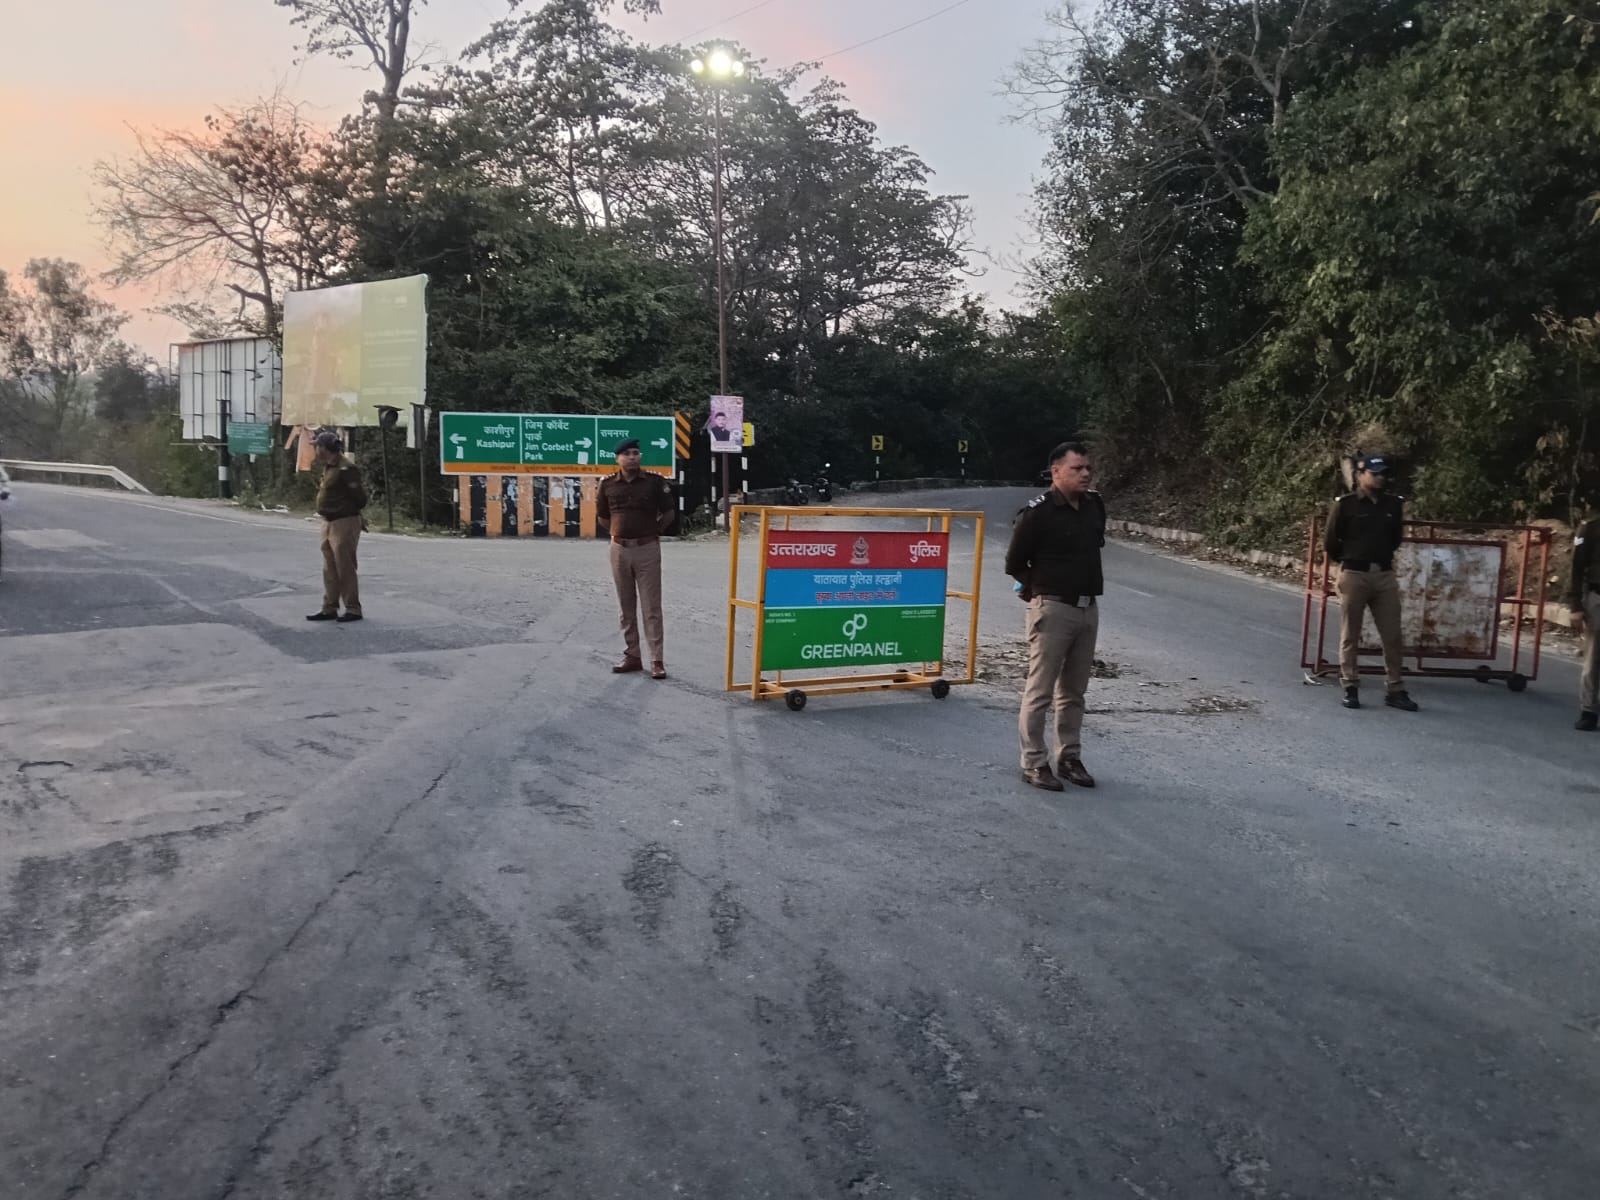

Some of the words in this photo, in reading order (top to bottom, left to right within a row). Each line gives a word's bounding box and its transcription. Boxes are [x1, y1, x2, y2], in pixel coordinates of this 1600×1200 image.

[525, 419, 543, 430] जिम
[483, 424, 515, 439] काशीपुर
[525, 432, 543, 441] पार्क
[477, 440, 516, 449] Kashipur
[525, 443, 540, 451] Jim
[542, 443, 574, 452] Corbett
[525, 453, 544, 461] Park
[769, 544, 838, 557] उत्तराखण्ड
[910, 541, 941, 563] पुलिस
[813, 574, 847, 585] यातायात
[850, 571, 873, 588] पुलिस
[801, 642, 902, 659] GREENPANEL
